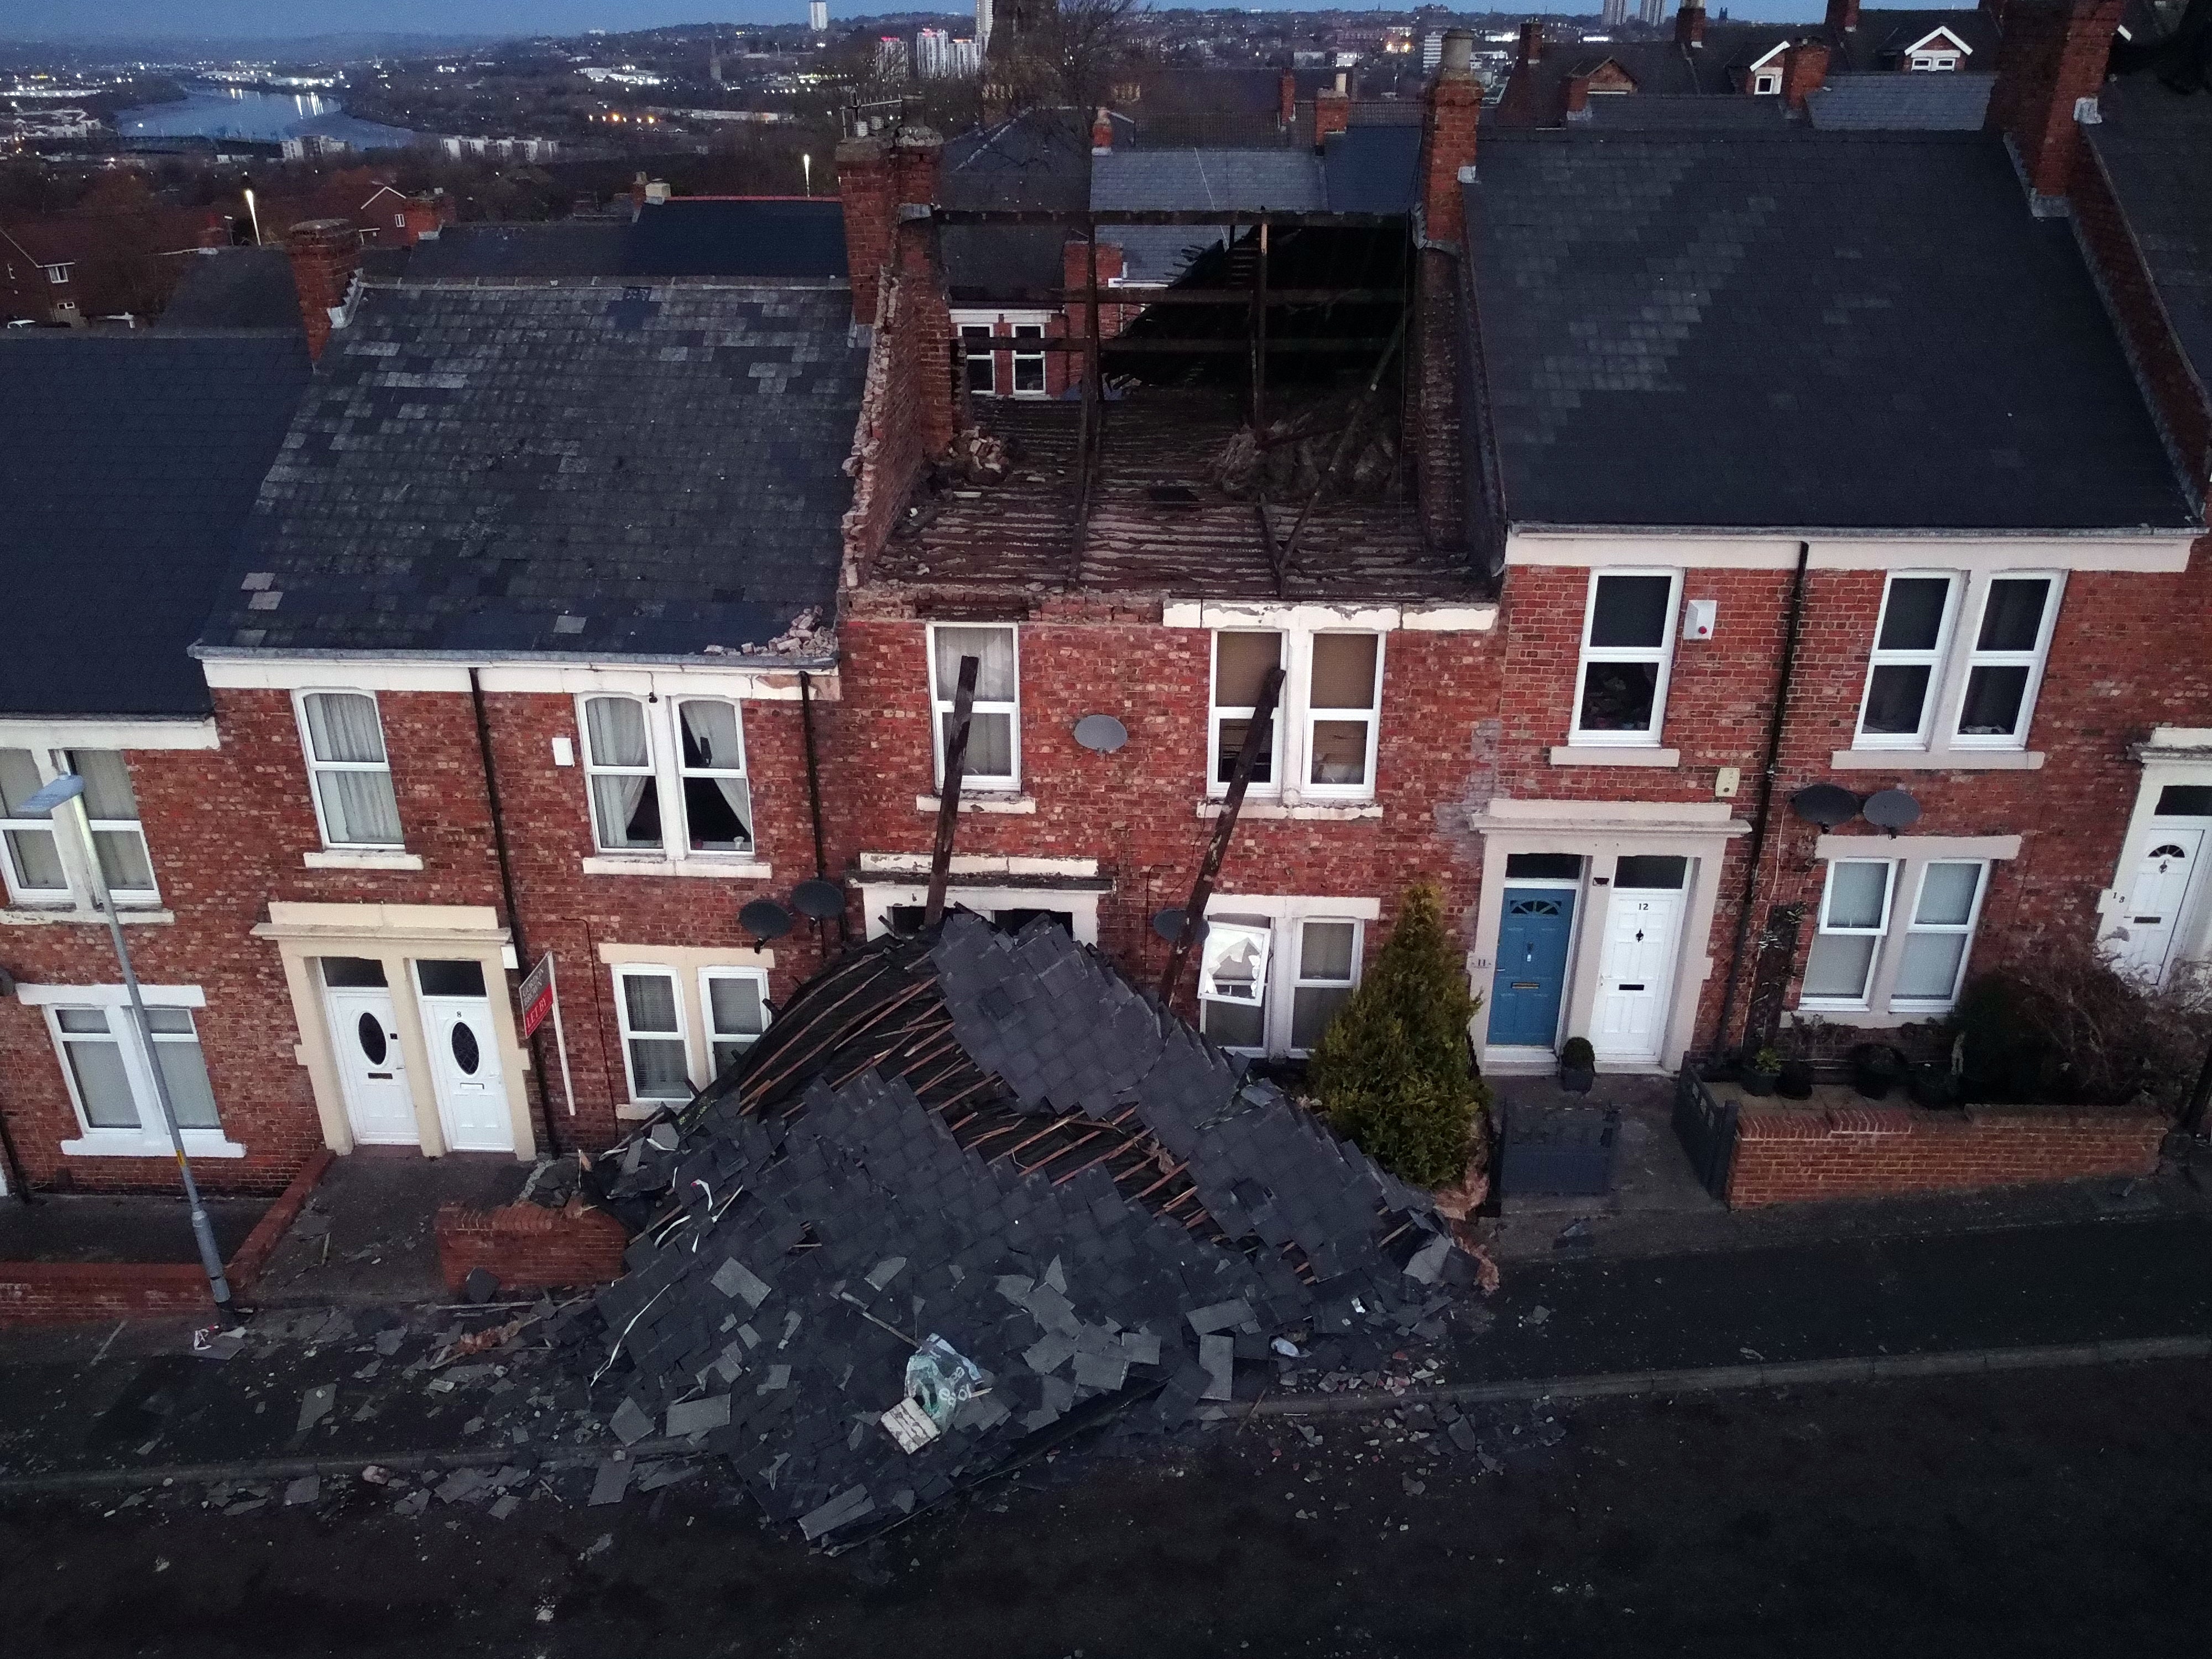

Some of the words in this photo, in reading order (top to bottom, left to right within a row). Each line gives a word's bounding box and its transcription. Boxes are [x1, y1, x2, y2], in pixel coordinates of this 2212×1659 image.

[2113, 892, 2125, 902] 13
[526, 1005, 539, 1028] LET
[539, 997, 546, 1012] BY
